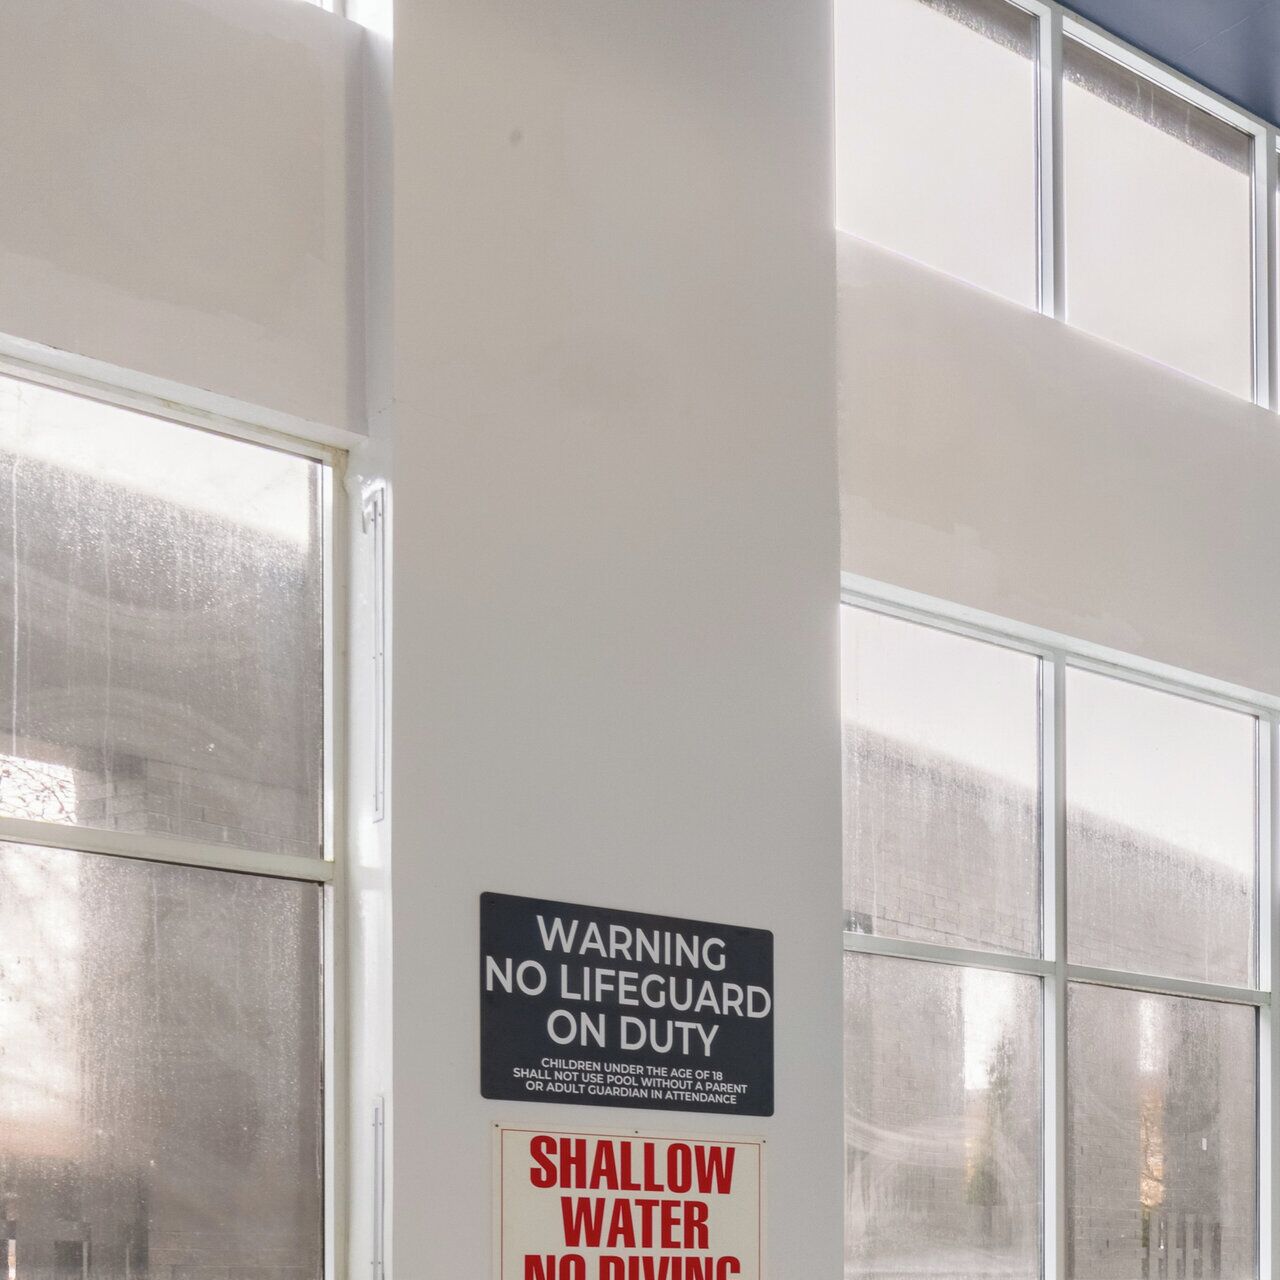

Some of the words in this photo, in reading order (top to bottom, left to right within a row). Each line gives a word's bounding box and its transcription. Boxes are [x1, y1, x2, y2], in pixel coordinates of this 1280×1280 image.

[536, 915, 726, 971] WARNING
[486, 956, 547, 996] NO
[560, 964, 772, 1019] LIFEGUARD
[547, 1009, 606, 1048] ON
[620, 1016, 719, 1057] DUTY
[513, 1067, 552, 1080] SHALL
[554, 1071, 578, 1082] NOT
[581, 1073, 604, 1084] USE
[606, 1075, 638, 1086] POOL
[640, 1077, 694, 1090] WITHOUT
[695, 1081, 704, 1090] A
[706, 1082, 748, 1094] PARENT
[525, 1080, 543, 1092] OR
[547, 1082, 585, 1094] ADULT
[588, 1084, 649, 1098] GUARDIAN
[651, 1089, 663, 1099] IN
[664, 1090, 737, 1105] ATTENDANCE
[541, 1057, 601, 1072] CHILDREN
[604, 1062, 644, 1075] UNDER
[646, 1066, 669, 1077] THE
[670, 1067, 693, 1079] AGE
[694, 1070, 710, 1080] OF
[712, 1071, 723, 1081] 18
[529, 1135, 736, 1195] SHALLOW
[560, 1196, 709, 1249] WATER
